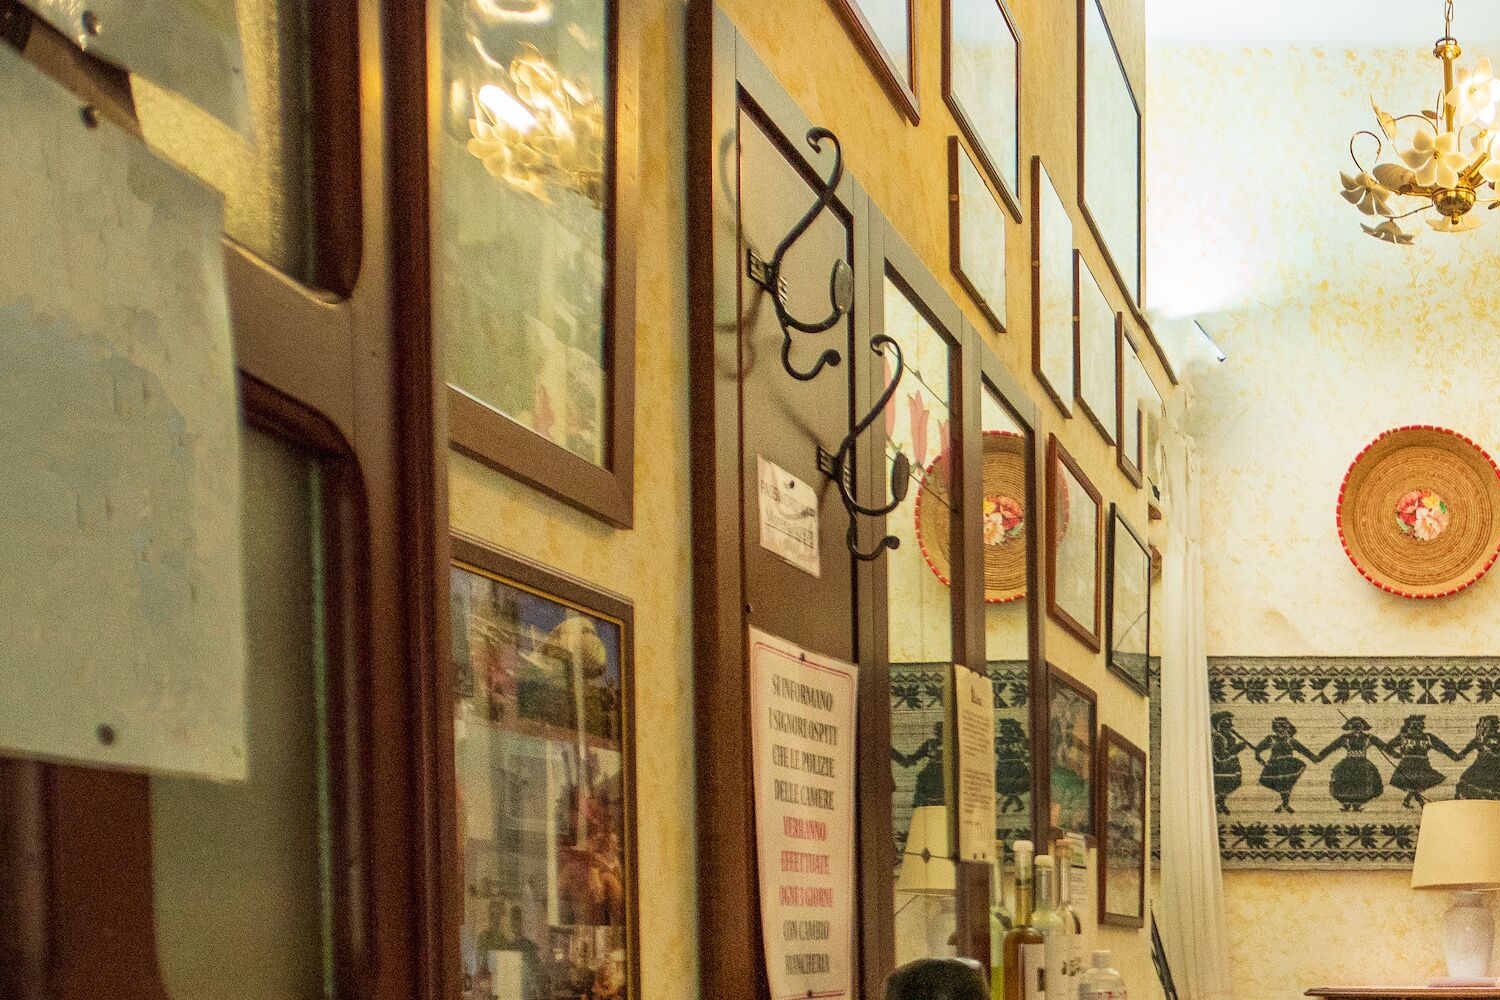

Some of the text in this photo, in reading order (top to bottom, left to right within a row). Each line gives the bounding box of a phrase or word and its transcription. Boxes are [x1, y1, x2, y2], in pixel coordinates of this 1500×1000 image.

[781, 677, 834, 712] INFORMANO
[773, 709, 807, 739] SIGNORI
[808, 719, 838, 746] OSPITI
[772, 744, 835, 778] CHE LE PULIZIE
[774, 778, 835, 811] DELLE CAMERE
